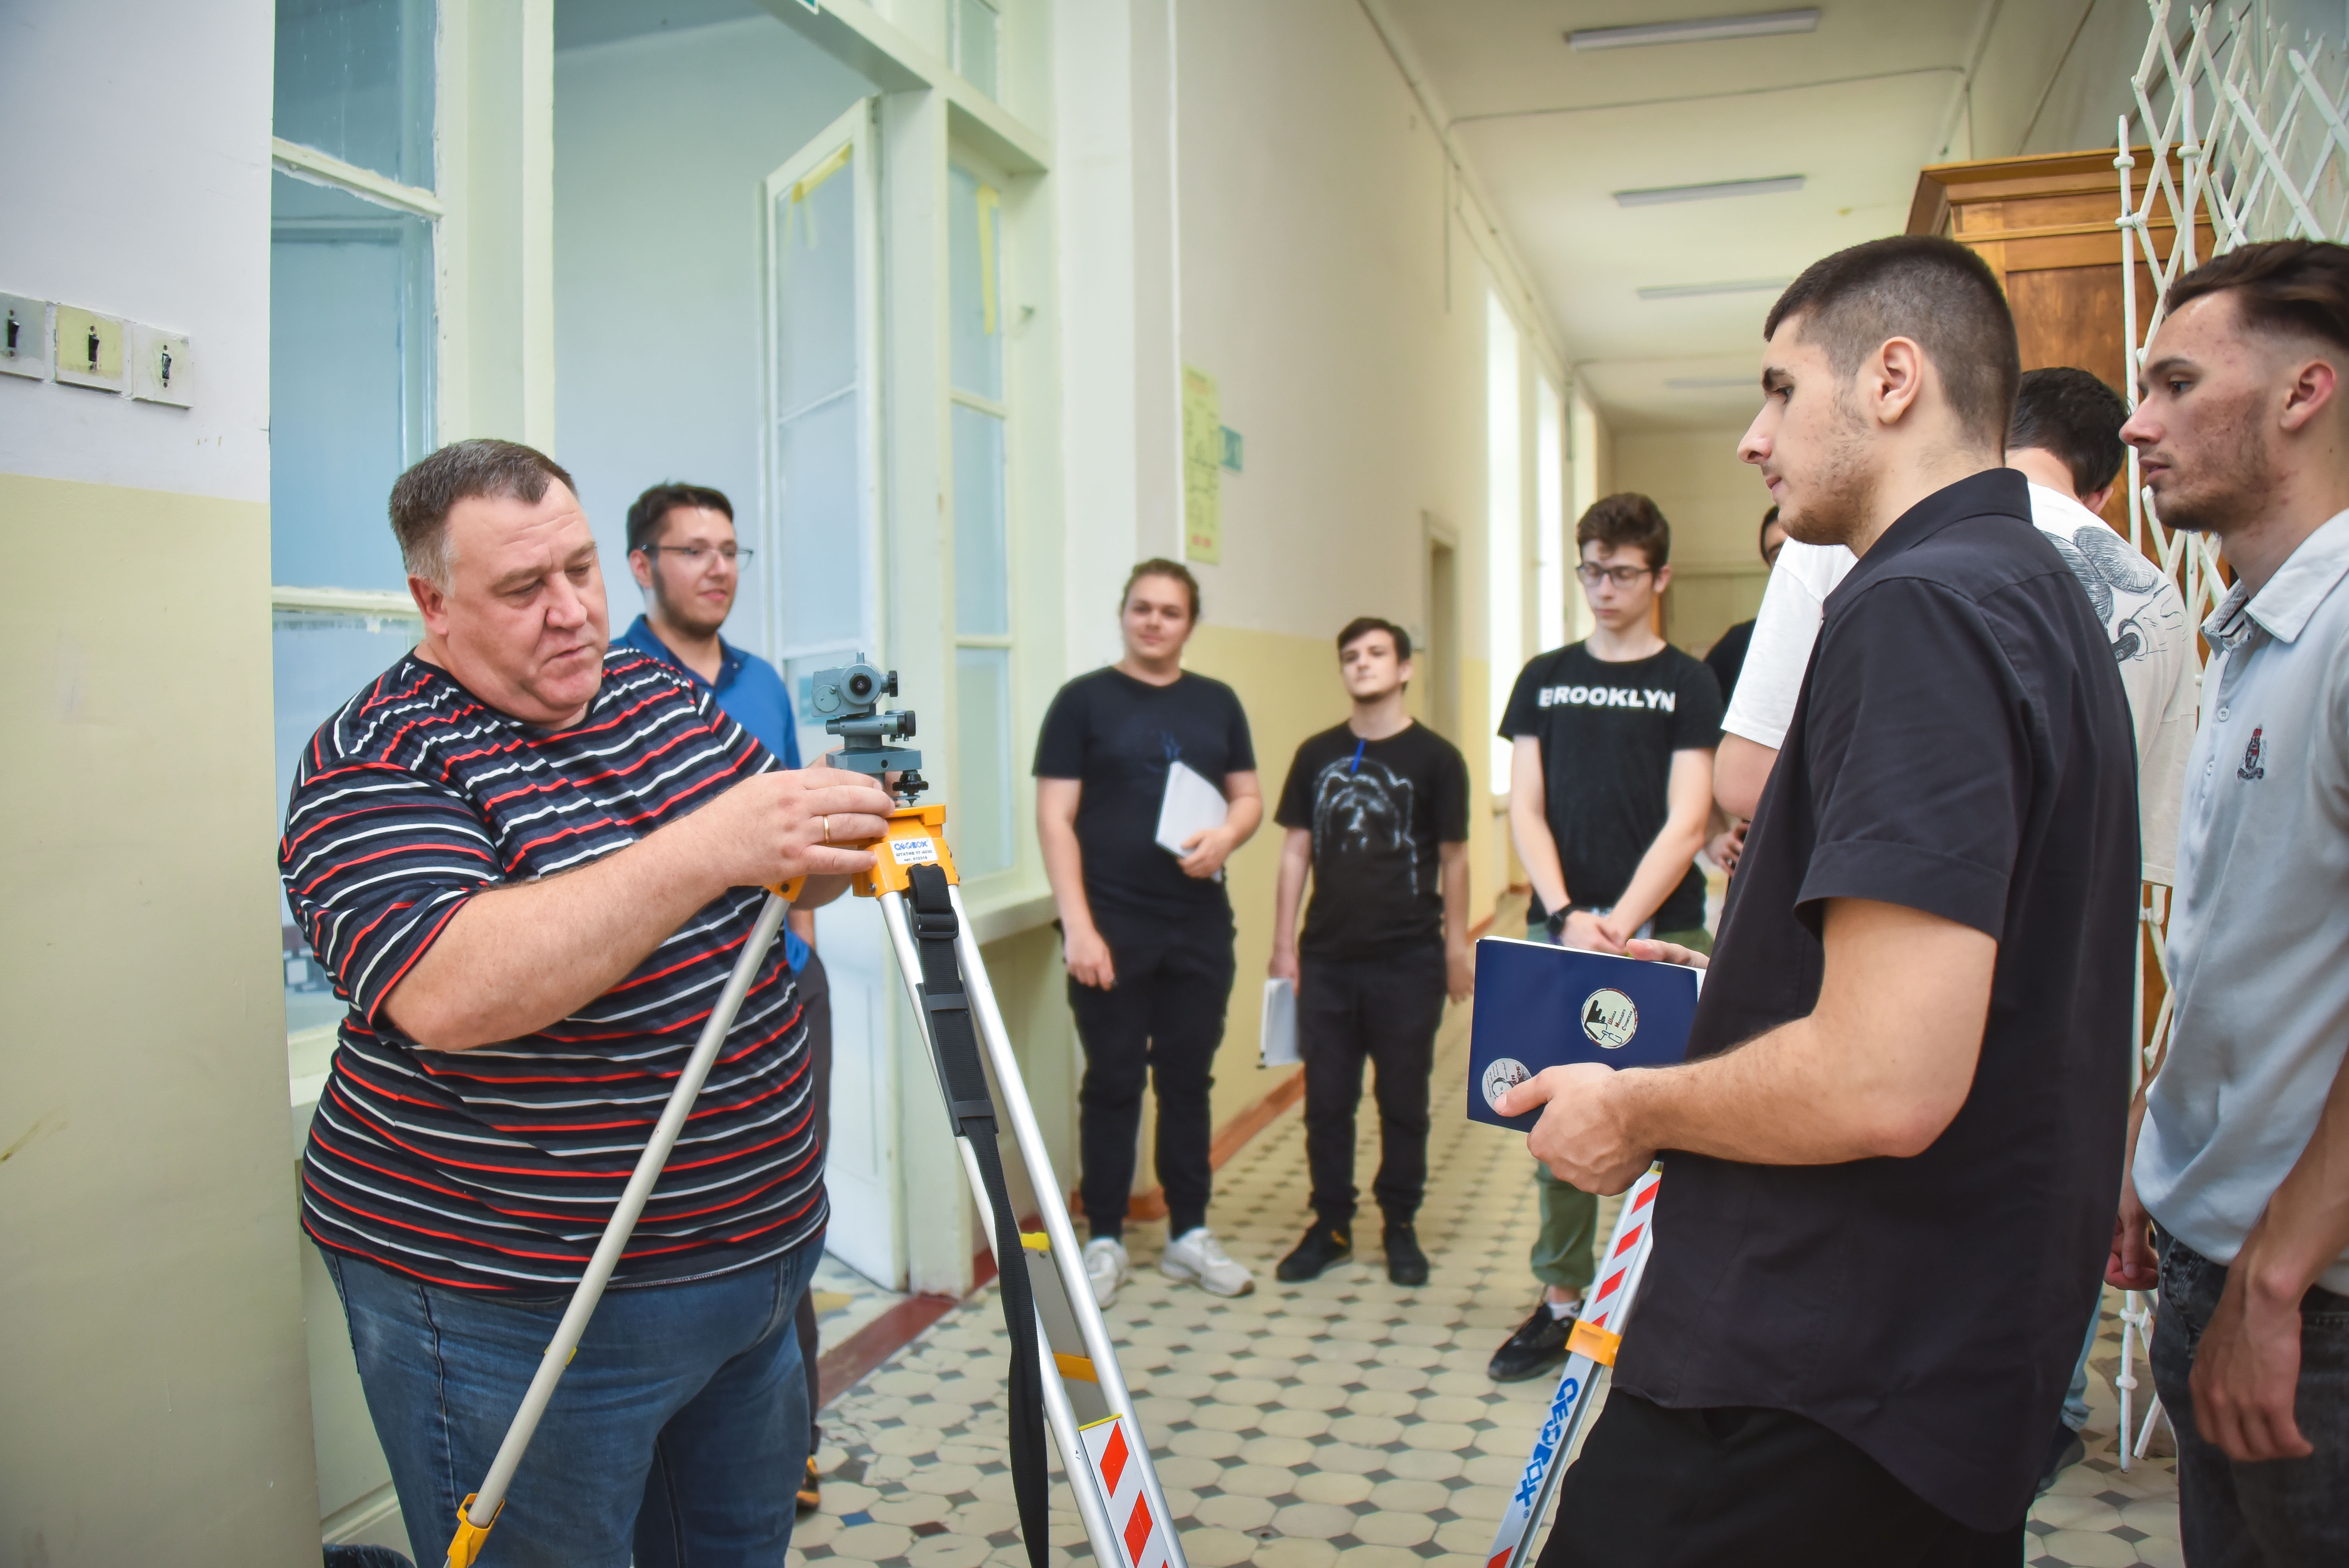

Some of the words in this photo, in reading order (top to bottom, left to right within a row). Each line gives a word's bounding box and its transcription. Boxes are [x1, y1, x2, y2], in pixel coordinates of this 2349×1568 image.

[1538, 686, 1675, 712] BROOKLYN
[894, 841, 928, 850] GEOBOX
[1515, 1377, 1578, 1507] GEOBOX
